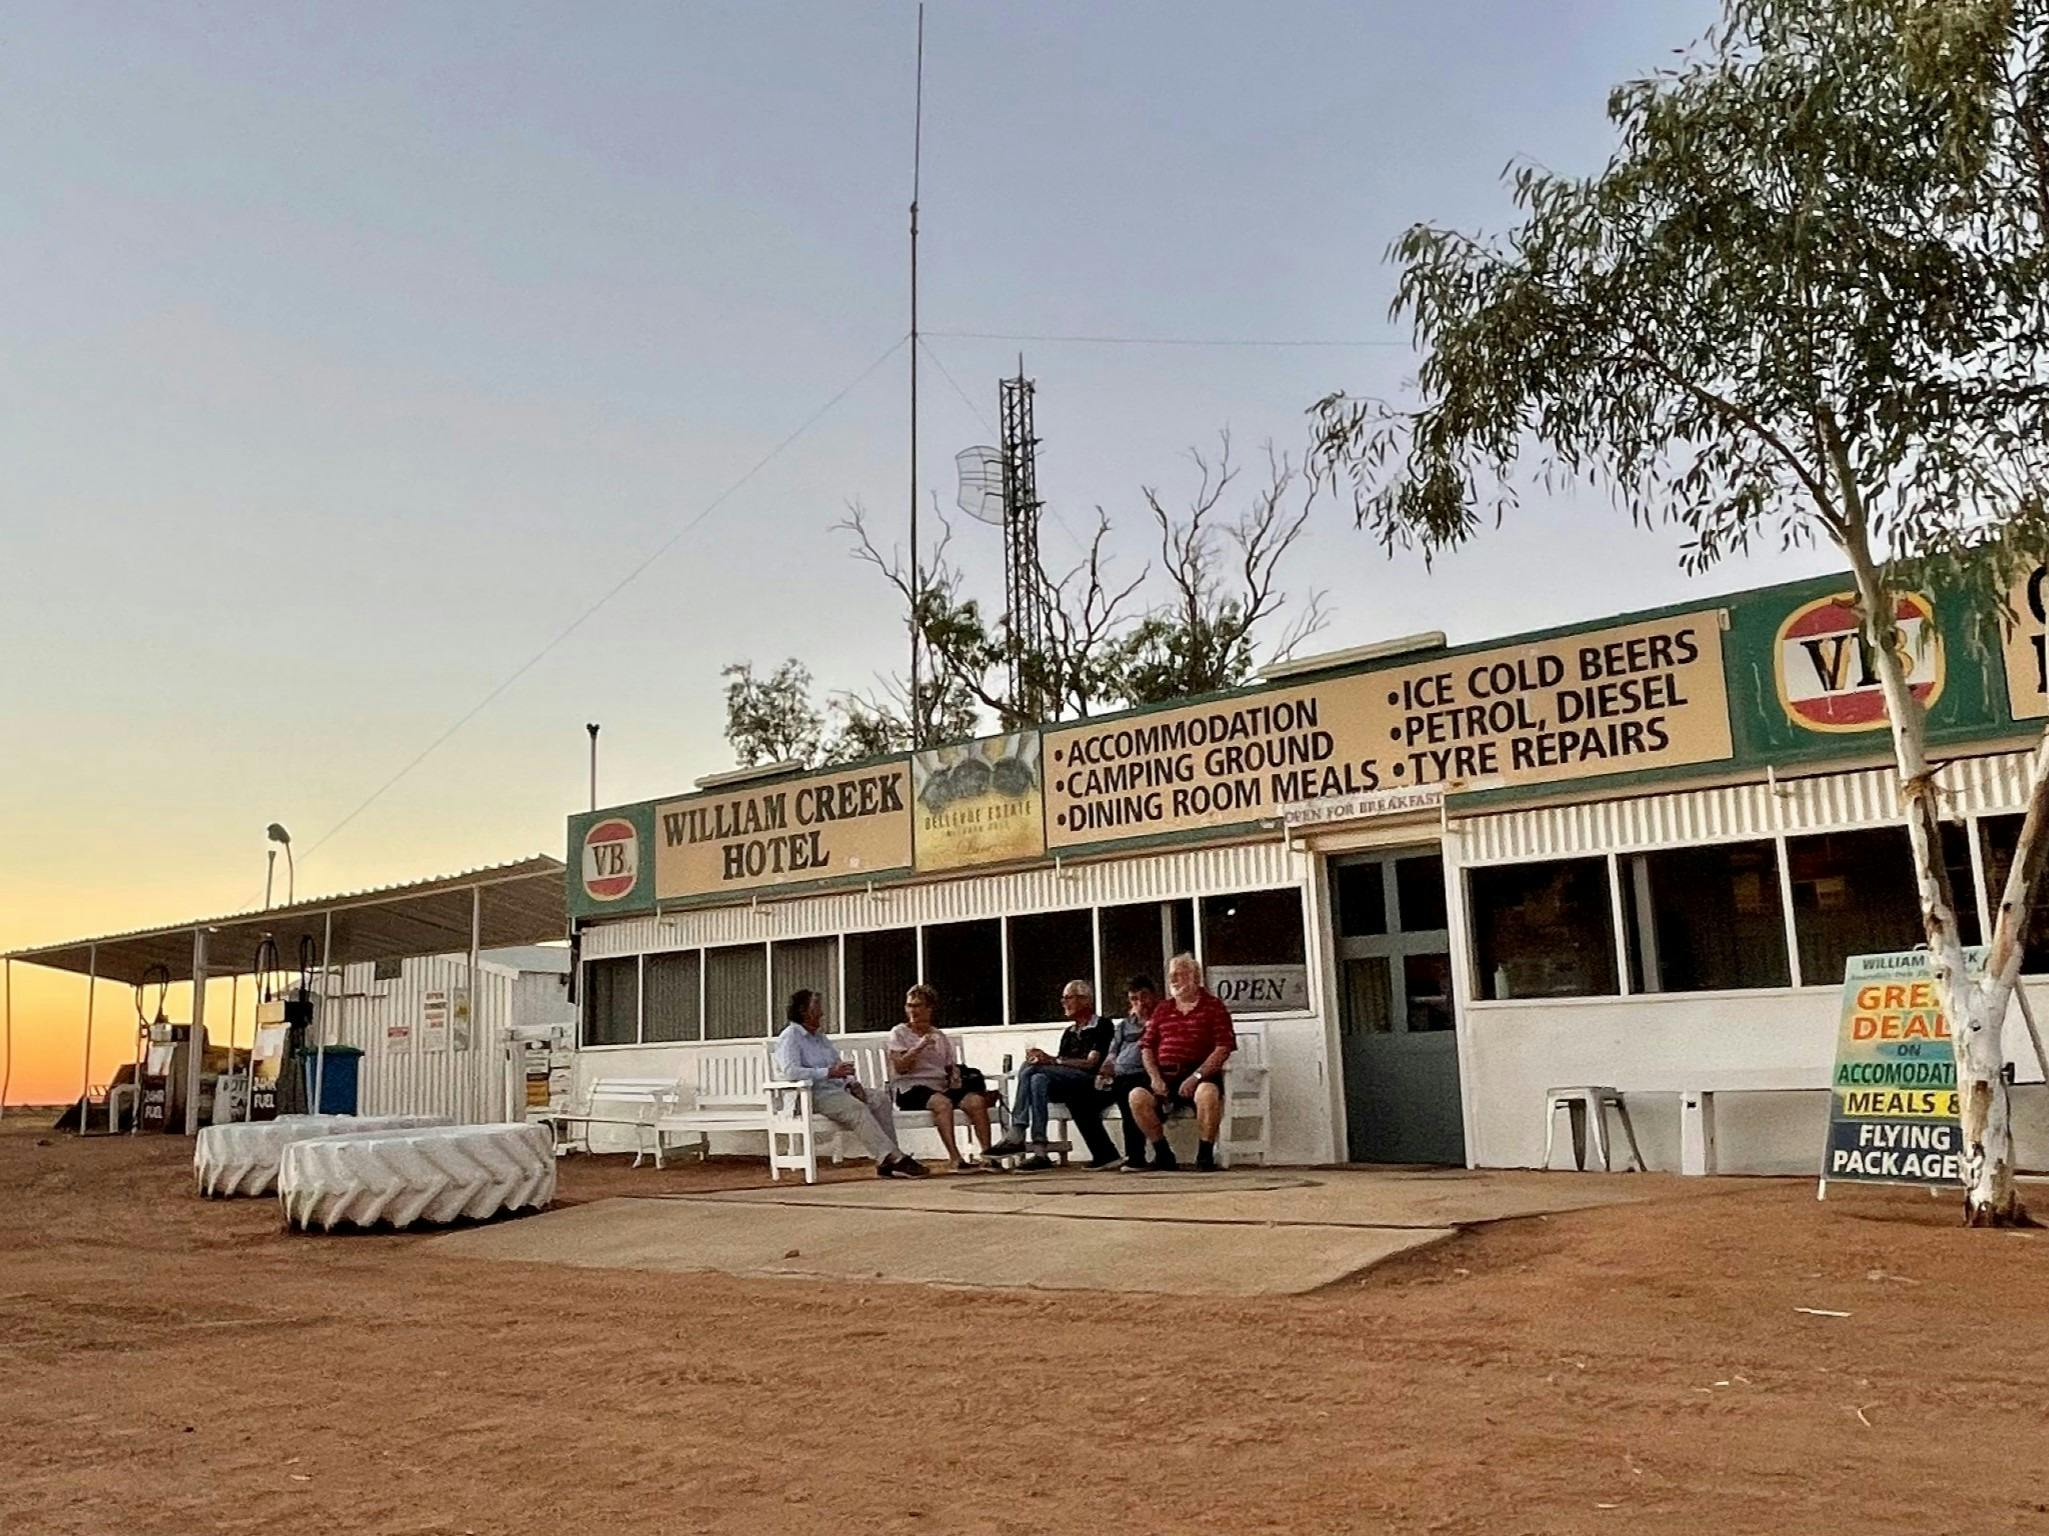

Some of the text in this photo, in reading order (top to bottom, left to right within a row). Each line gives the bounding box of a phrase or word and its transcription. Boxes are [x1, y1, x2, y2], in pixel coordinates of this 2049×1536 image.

[1403, 629, 1699, 711] ICE COLD BEERS
[1405, 673, 1689, 747] PETROL, DIESEL
[1067, 697, 1319, 768] ACCOMMODATION
[1067, 731, 1334, 798] CAMPING GROUND
[1408, 716, 1669, 785] TYRE REPAIRS
[663, 772, 904, 848] WILLIAM CREEK
[988, 800, 1032, 821] ESTATE
[1069, 759, 1379, 832] DINING ROOM MEALS
[1285, 792, 1442, 824] OPEN FOR BREAKFAST
[592, 843, 625, 876] VB
[722, 830, 830, 881] HOTEL
[1862, 955, 1925, 970] WILLIAM
[1217, 978, 1286, 1001] OPEN
[1856, 983, 1940, 1010] GRE
[1853, 1014, 1952, 1040] DEAL
[1897, 1044, 1921, 1056] ON
[1847, 1093, 1936, 1113] MEALS
[1859, 1125, 1950, 1150] FLYING
[1832, 1151, 1959, 1178] PACKAGE
